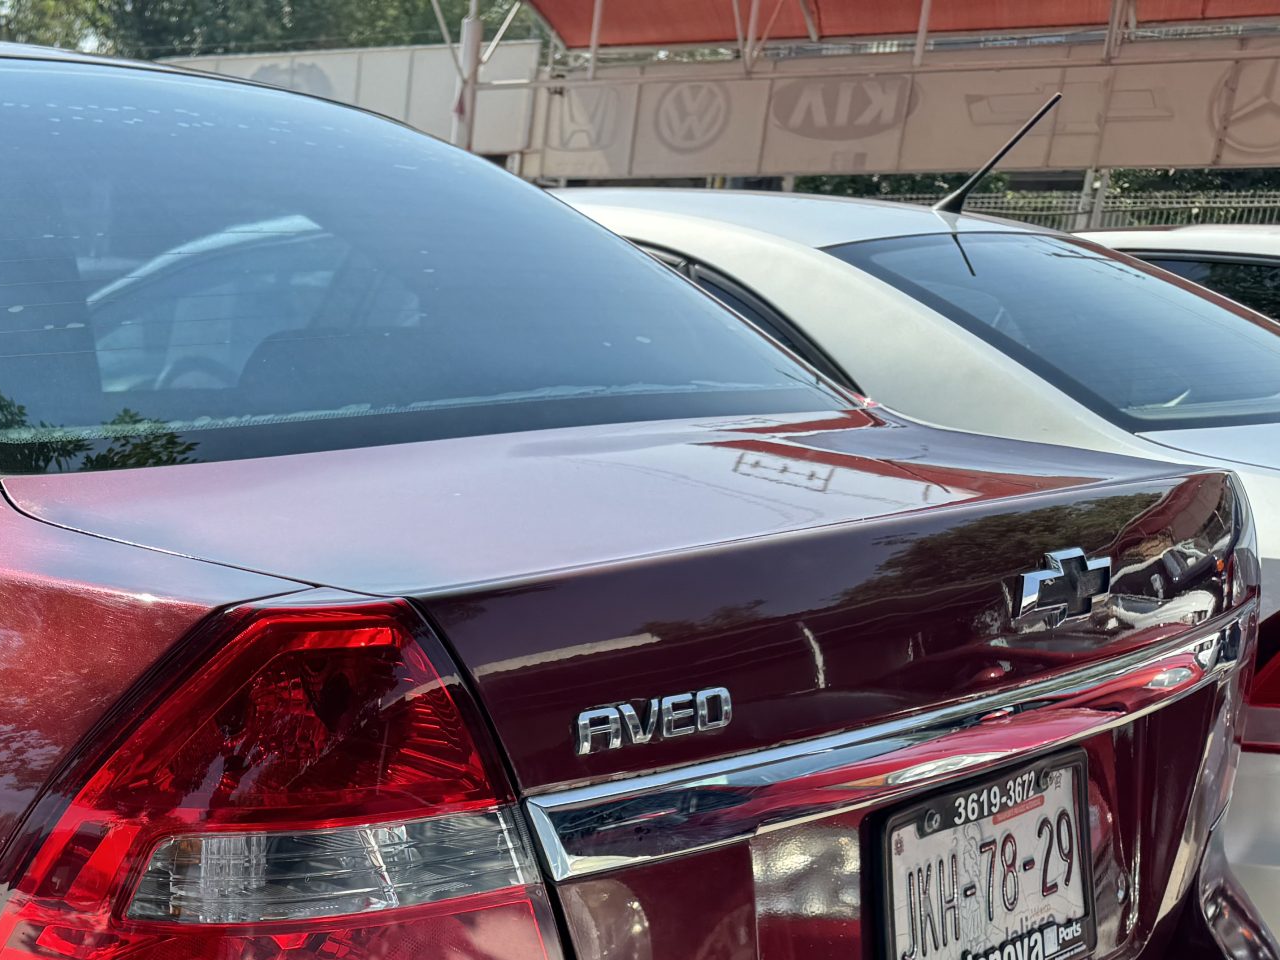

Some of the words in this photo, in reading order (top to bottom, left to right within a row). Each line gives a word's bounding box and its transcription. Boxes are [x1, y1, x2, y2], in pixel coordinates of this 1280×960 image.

[577, 686, 733, 756] AVEO
[953, 770, 1035, 825] 3619-3672
[1058, 921, 1082, 944] Parts
